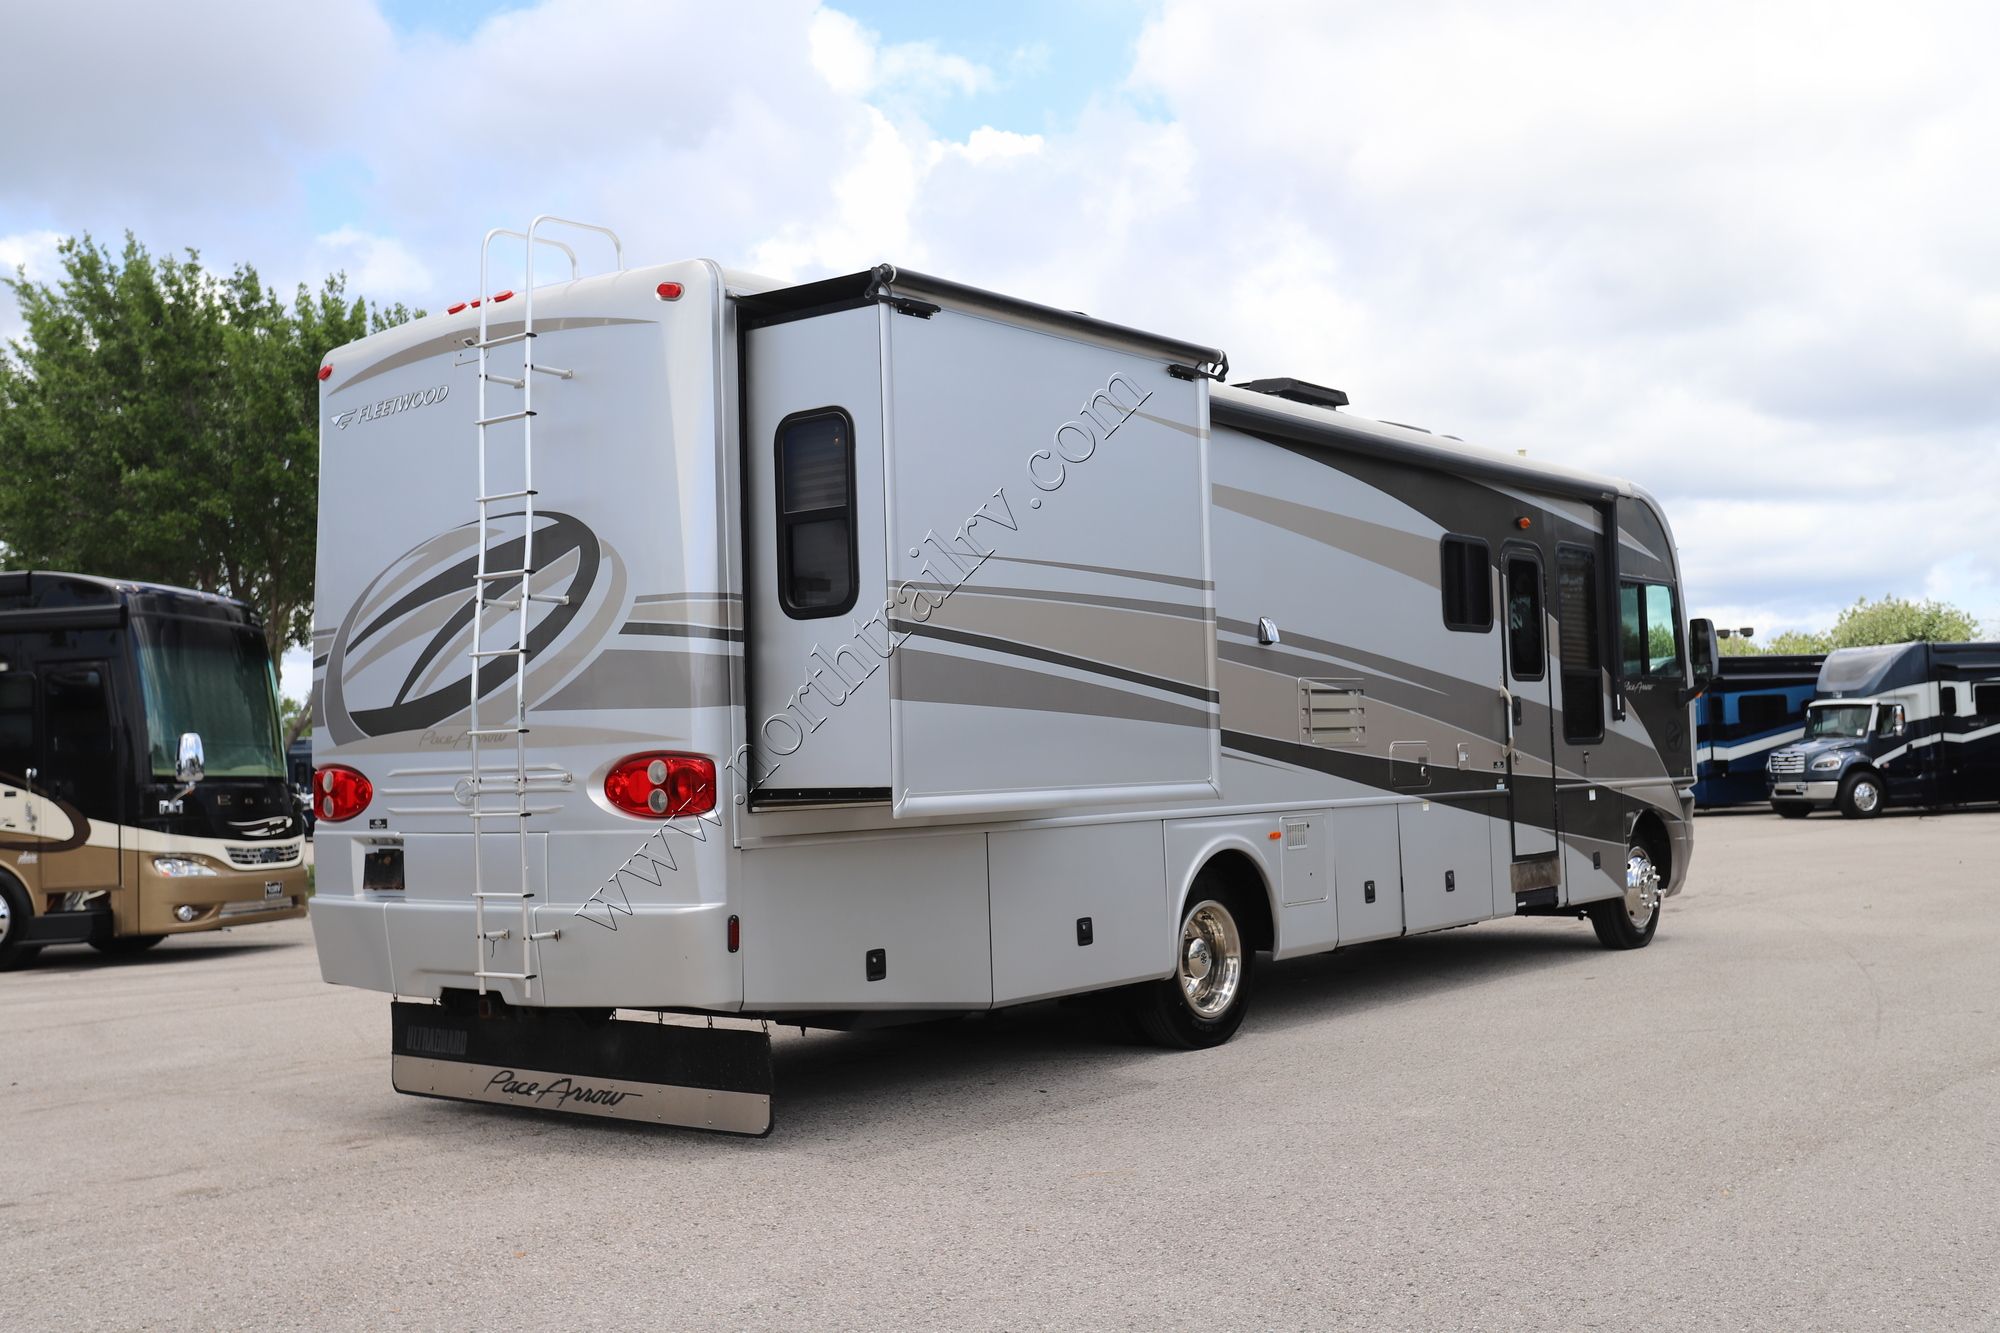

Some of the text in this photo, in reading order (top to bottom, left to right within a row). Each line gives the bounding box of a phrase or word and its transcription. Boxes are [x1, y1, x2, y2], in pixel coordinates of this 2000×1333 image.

[358, 384, 449, 424] FLEETWOOD
[419, 729, 453, 748] Pace
[484, 1070, 643, 1108] Pace Arrow
